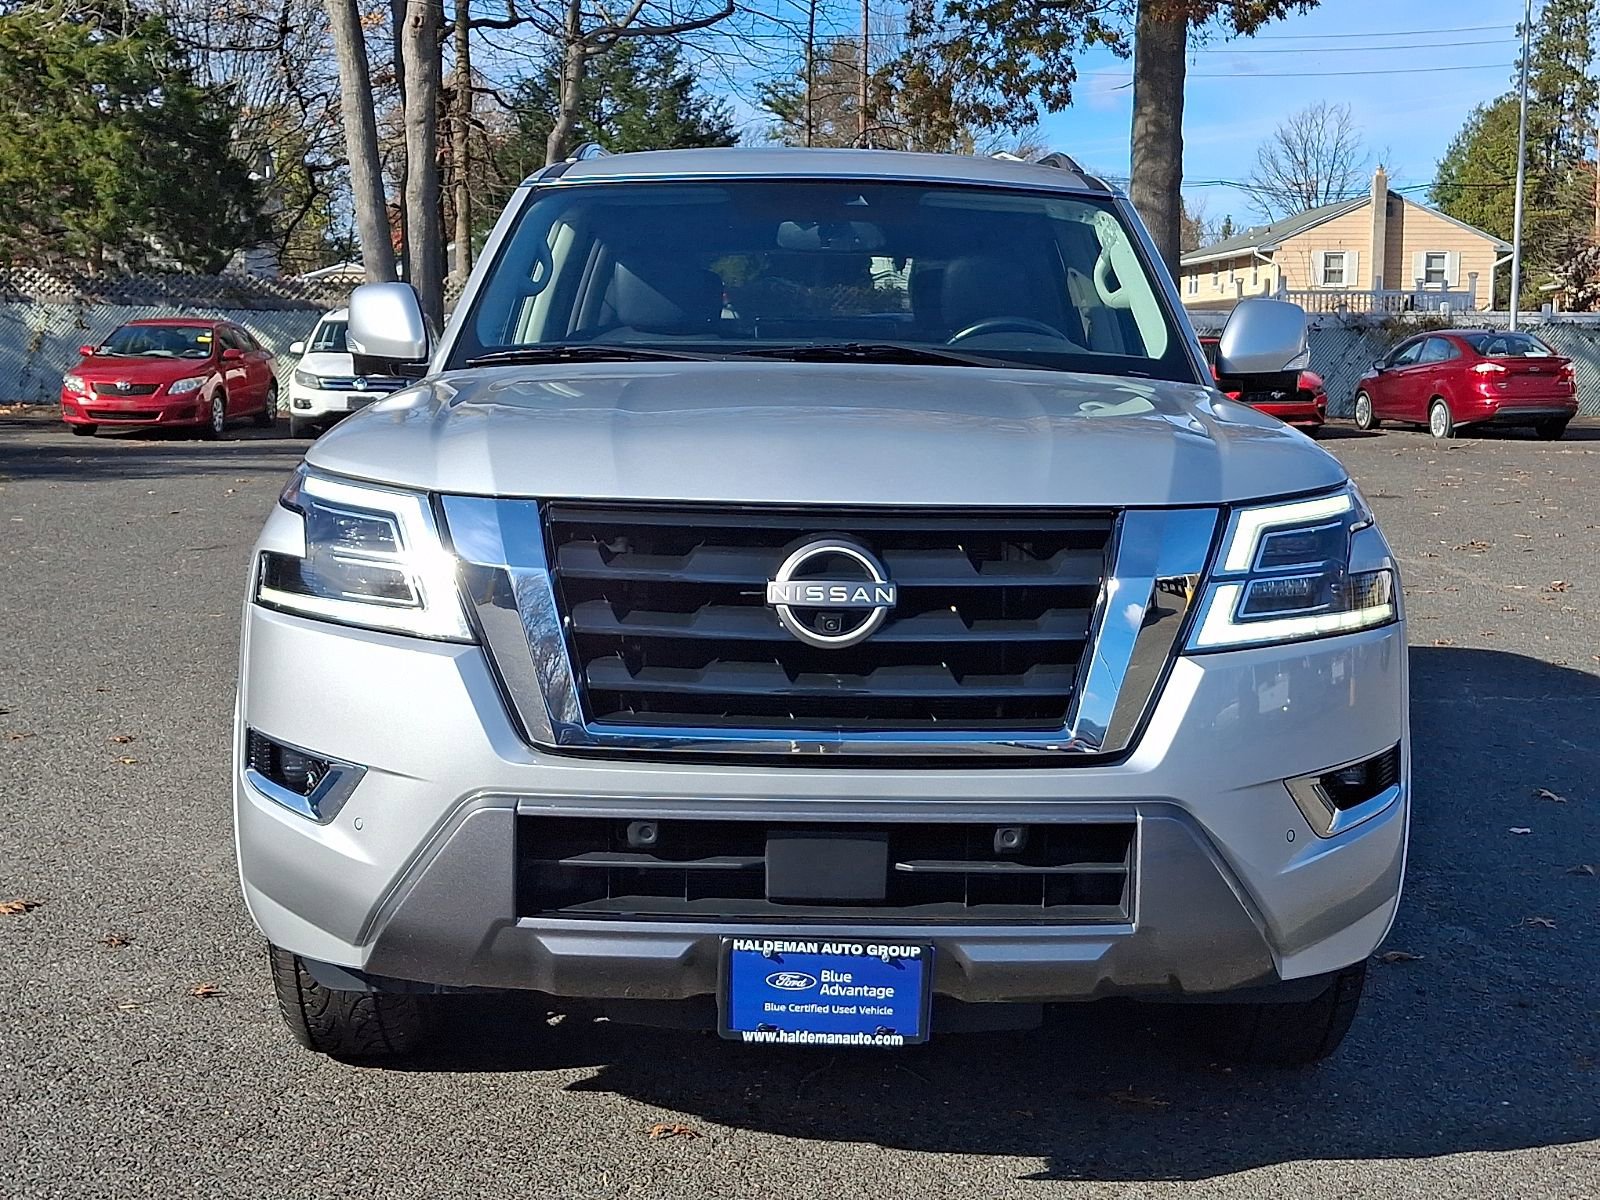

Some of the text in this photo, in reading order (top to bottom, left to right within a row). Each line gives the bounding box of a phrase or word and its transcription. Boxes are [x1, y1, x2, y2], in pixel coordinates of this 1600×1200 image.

[770, 586, 894, 603] NISSAN
[733, 939, 921, 957] HALDEMAN AUTO GROUP
[775, 974, 807, 988] Ford
[820, 970, 852, 983] Blue
[819, 984, 895, 999] Advantage
[764, 1003, 894, 1016] Blue Certified Used Vehicle
[742, 1030, 904, 1046] www.haldemanauto.com
